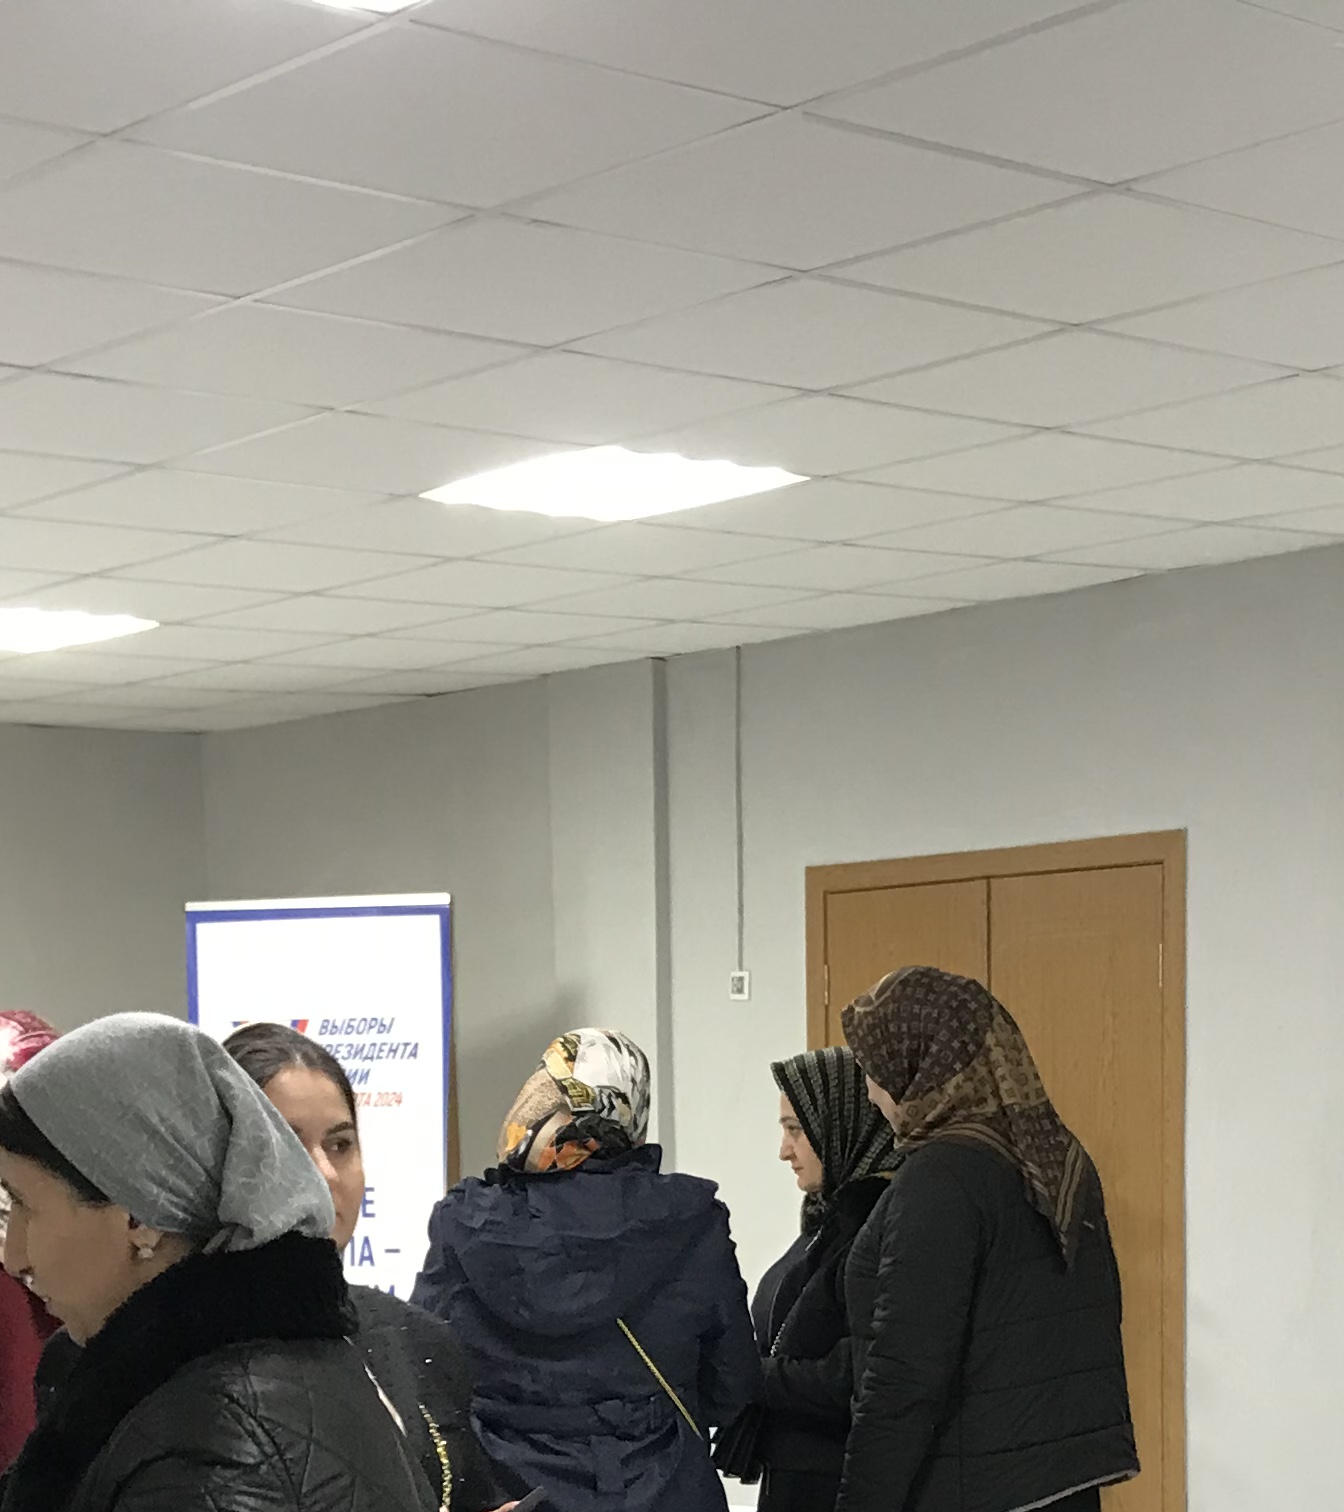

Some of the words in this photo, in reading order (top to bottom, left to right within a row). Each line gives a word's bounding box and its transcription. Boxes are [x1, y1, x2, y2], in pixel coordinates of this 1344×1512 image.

[318, 1017, 396, 1036] ВЫБОРЫ
[321, 1042, 419, 1062] РЕЗИДЕНТА
[373, 1092, 403, 1108] 2024
